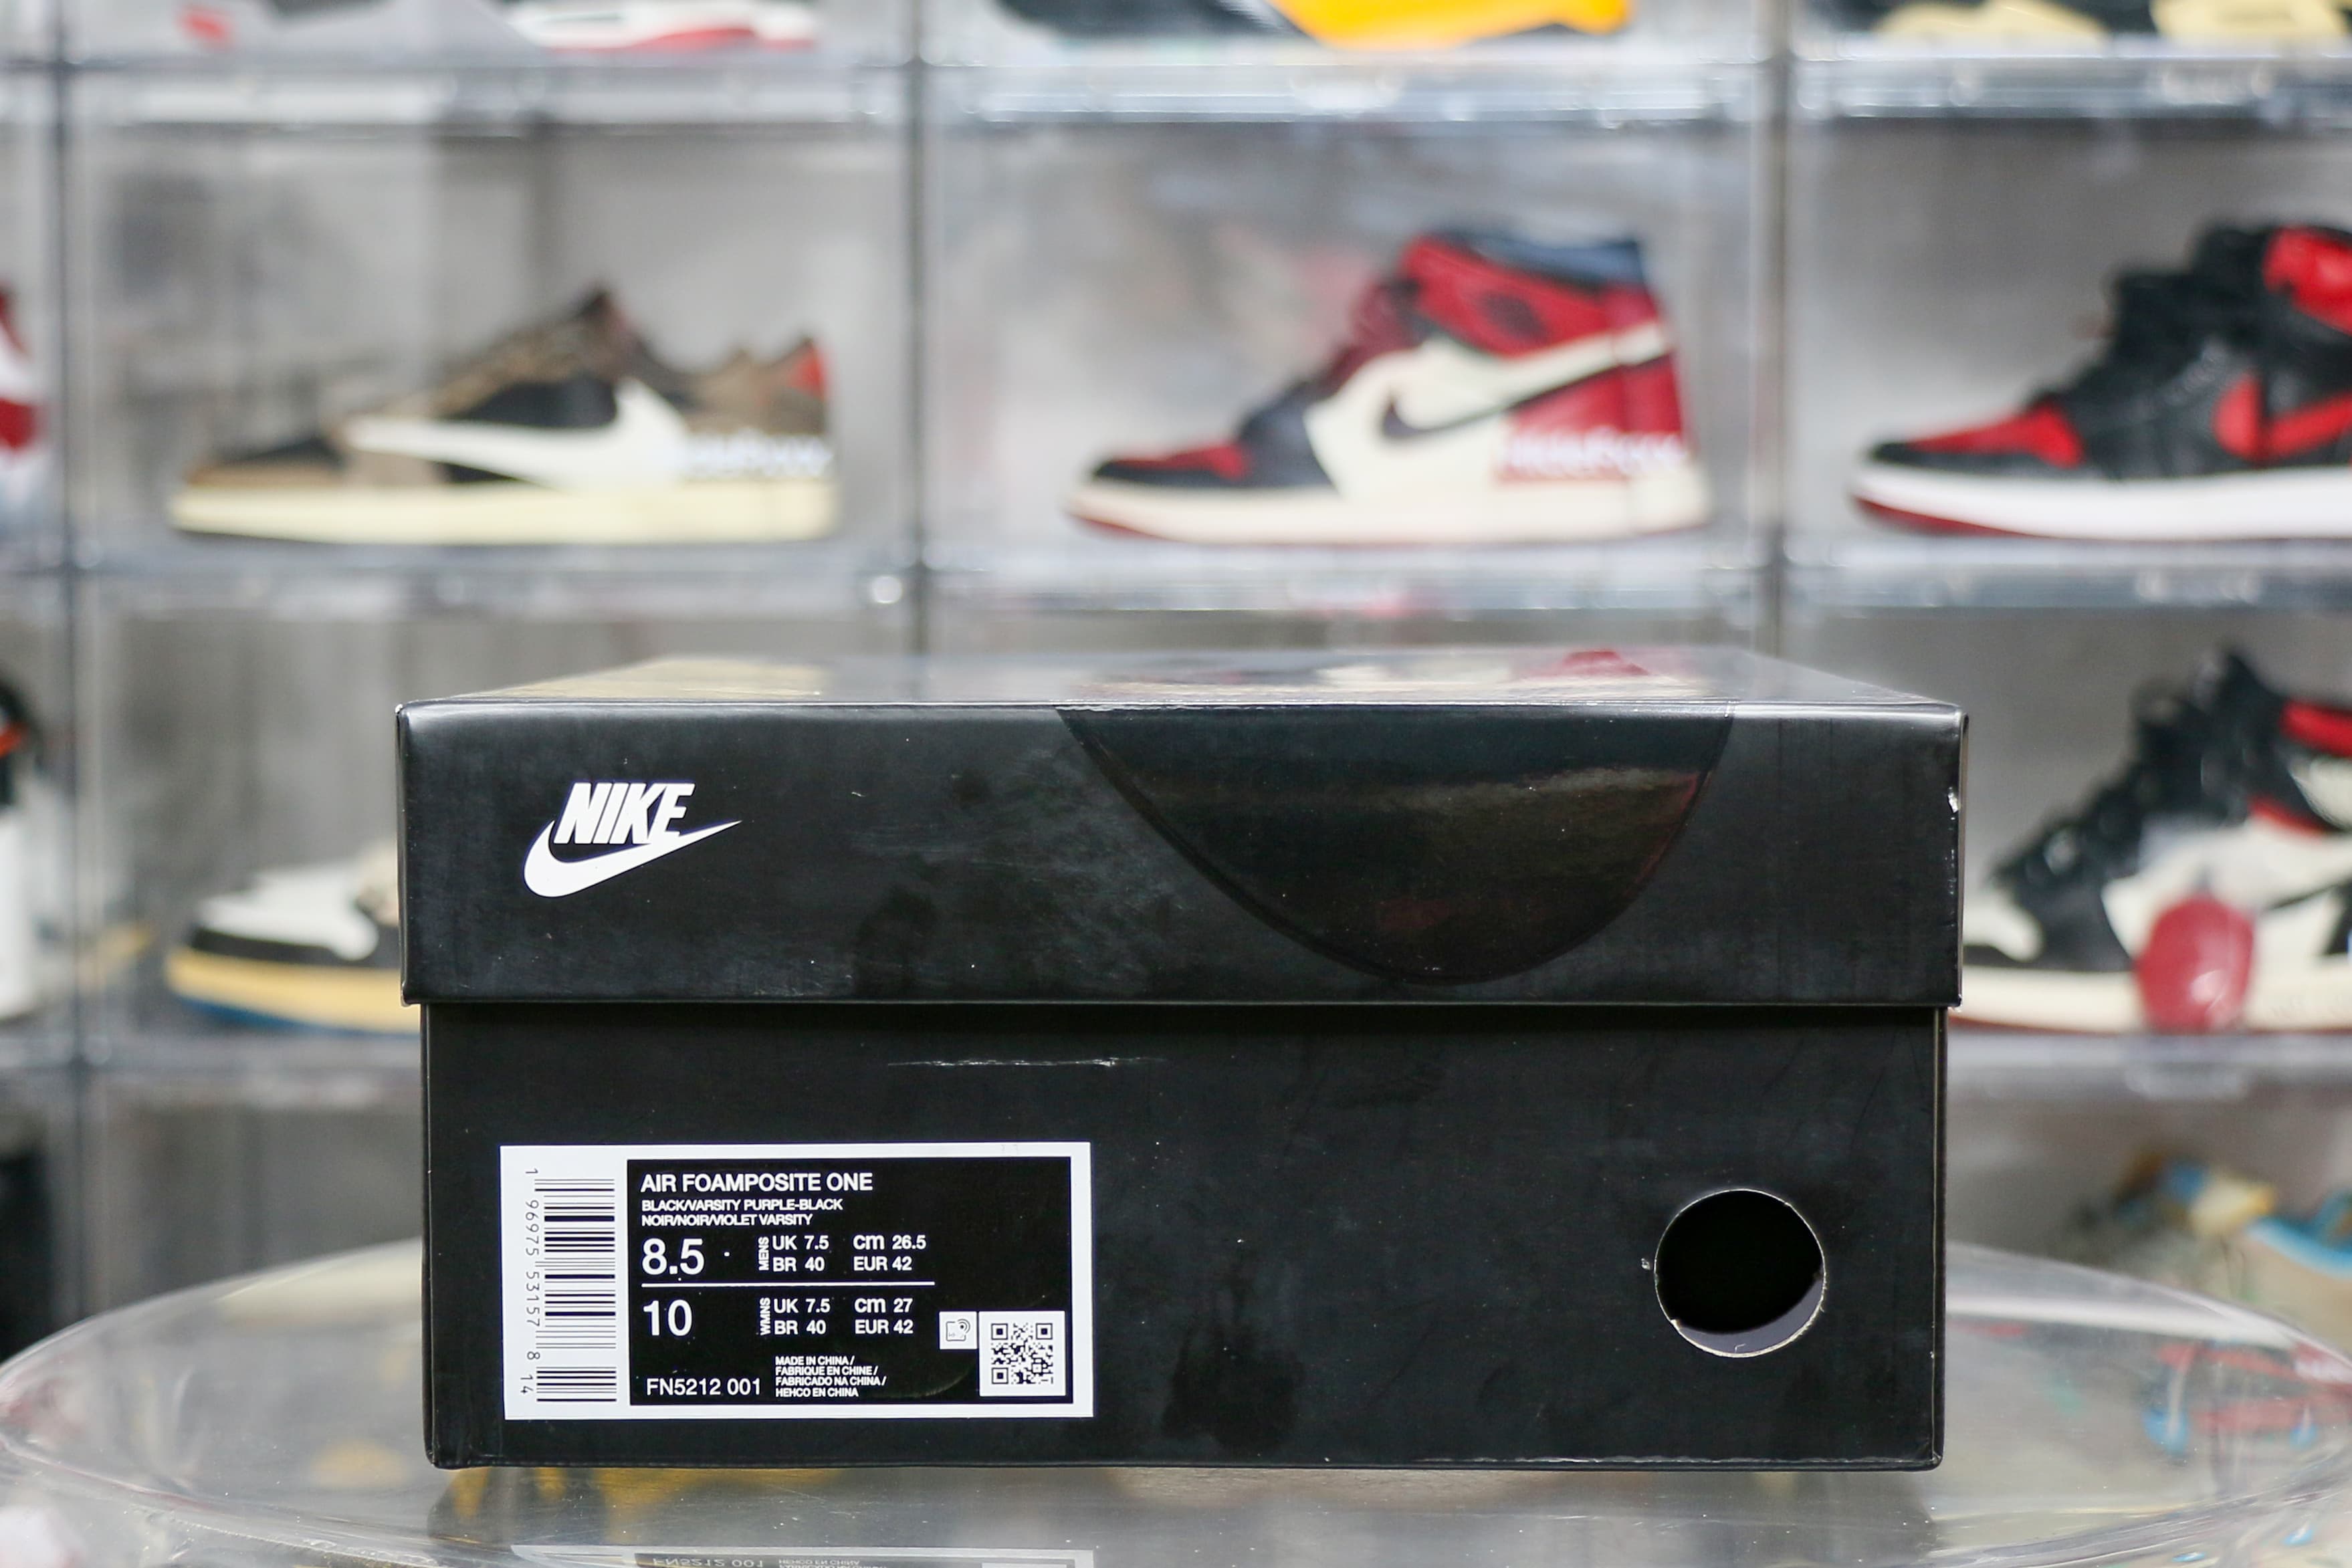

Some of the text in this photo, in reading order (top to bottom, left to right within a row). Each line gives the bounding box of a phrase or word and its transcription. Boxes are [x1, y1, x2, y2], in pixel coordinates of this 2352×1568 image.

[554, 782, 696, 845] NIKE
[640, 1172, 873, 1193] AIR FOAMPOSITE ONE
[641, 1198, 843, 1212] BLACK/VARSITY PURPLE-BLACK
[525, 1200, 540, 1256] 96975
[641, 1213, 813, 1227] NOIR/NOIR/VIOLET VARSITY
[772, 1234, 829, 1250] UK 7.5
[891, 1234, 927, 1250] 26.5
[642, 1238, 705, 1275] 8.5
[758, 1236, 770, 1271] MENS
[772, 1256, 825, 1272] BR 40
[853, 1256, 912, 1271] EUR 42
[526, 1271, 540, 1327] 53157
[773, 1298, 831, 1314] UK 7.5
[893, 1297, 914, 1313] 27
[643, 1299, 692, 1337] 10
[759, 1297, 771, 1336] WMNS
[774, 1319, 827, 1335] BR 40
[855, 1319, 914, 1335] EUR 42
[526, 1351, 541, 1360] 8
[774, 1355, 805, 1366] MADE
[805, 1355, 817, 1366] IN
[775, 1365, 826, 1376] FABRIQUE
[826, 1365, 841, 1376] EN
[520, 1374, 534, 1394] 14
[647, 1377, 760, 1395] FN5212 001
[775, 1376, 833, 1386] FABRICADO
[833, 1376, 849, 1386] NA
[775, 1387, 859, 1397] HEHCO EN CHINA
